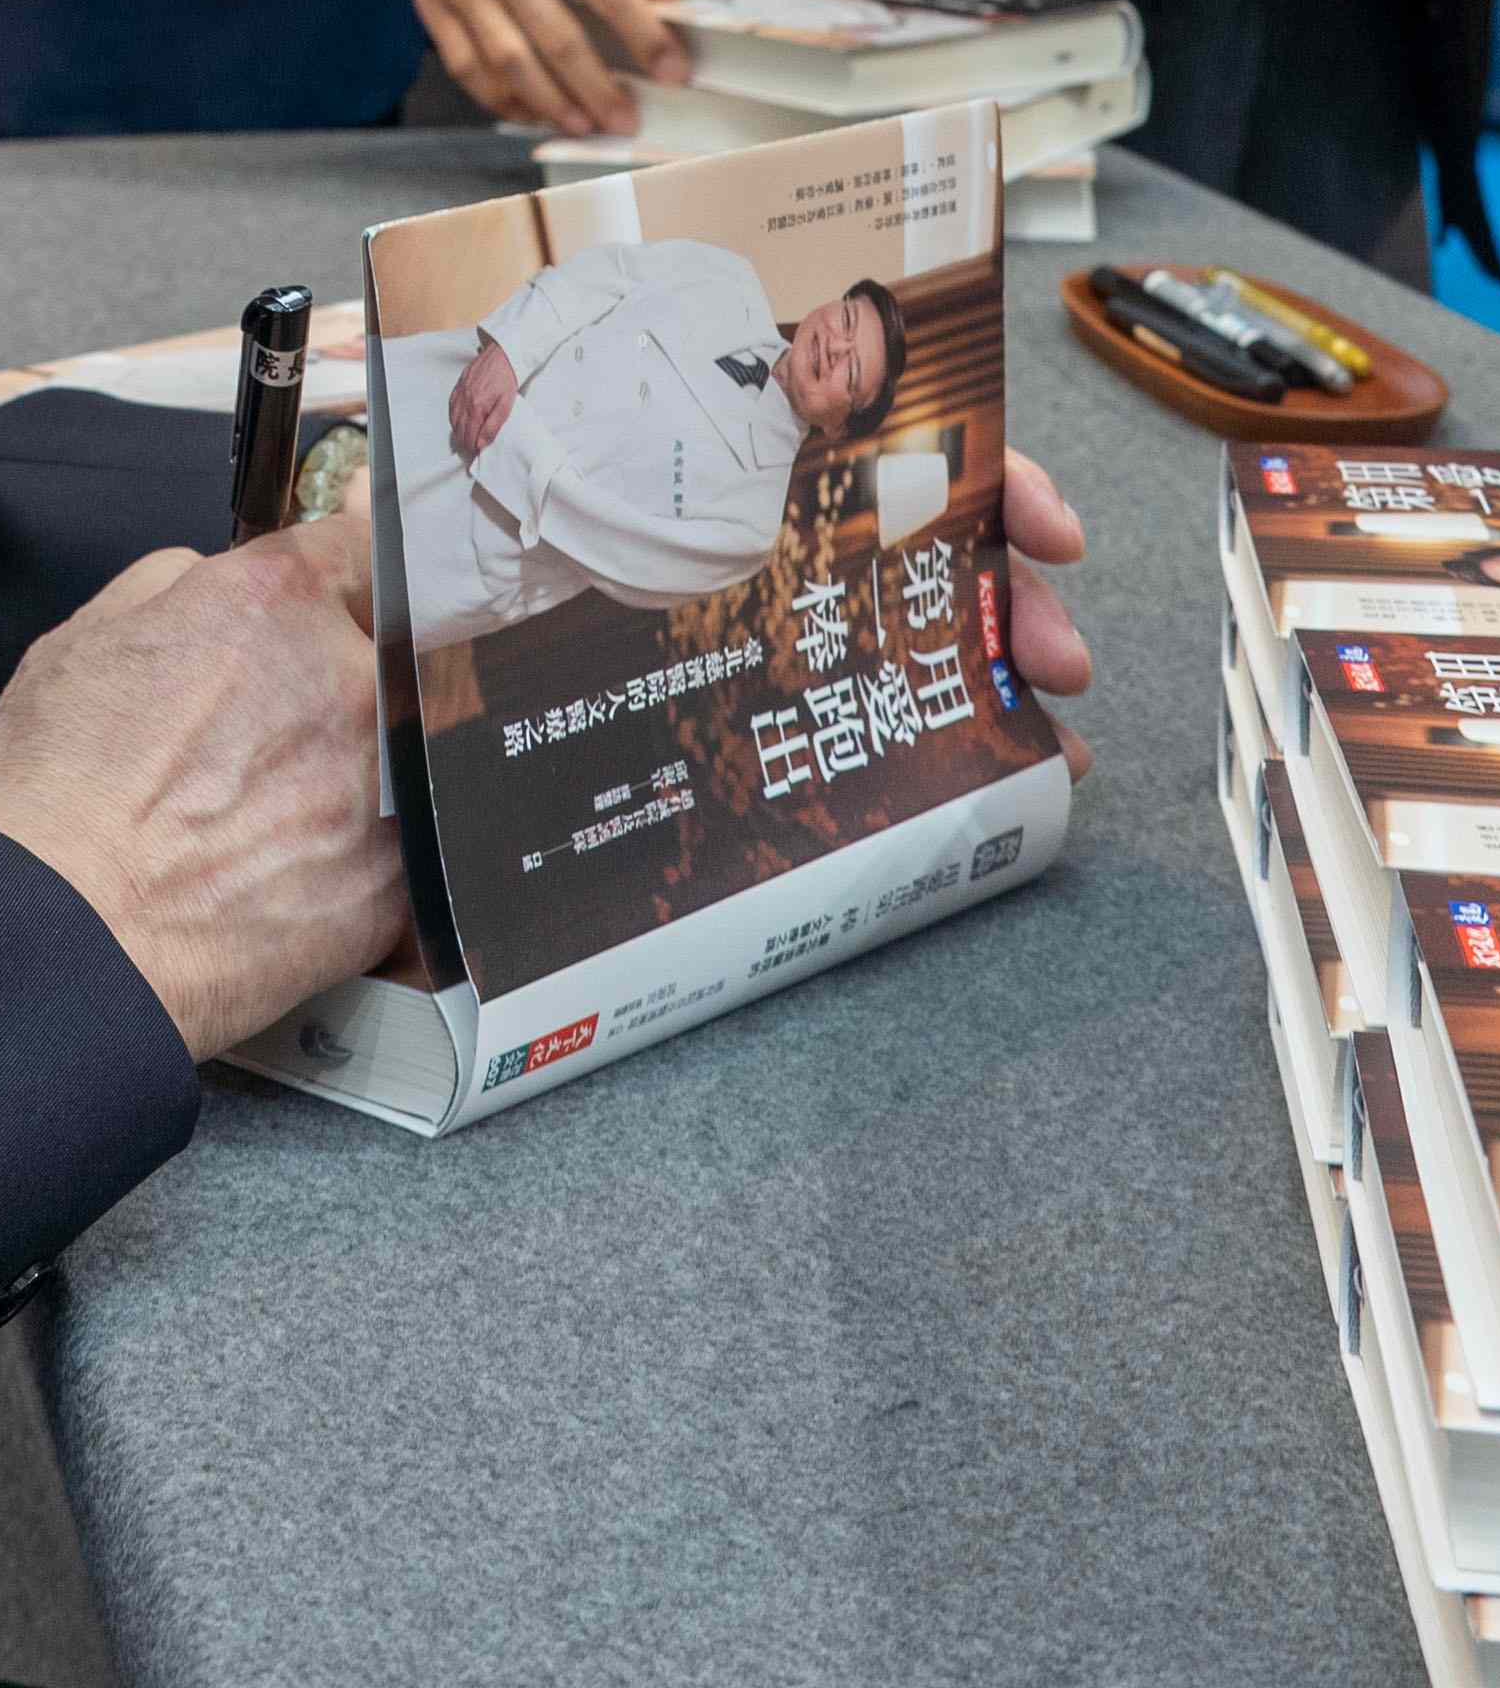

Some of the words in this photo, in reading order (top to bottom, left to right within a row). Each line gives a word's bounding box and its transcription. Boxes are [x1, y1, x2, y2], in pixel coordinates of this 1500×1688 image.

[792, 537, 954, 673] 第一棒
[503, 636, 763, 758] 臺北慈濟醫院的人文醫療之路
[751, 644, 975, 799] 用愛跑出
[530, 1017, 594, 1070] 天下文化
